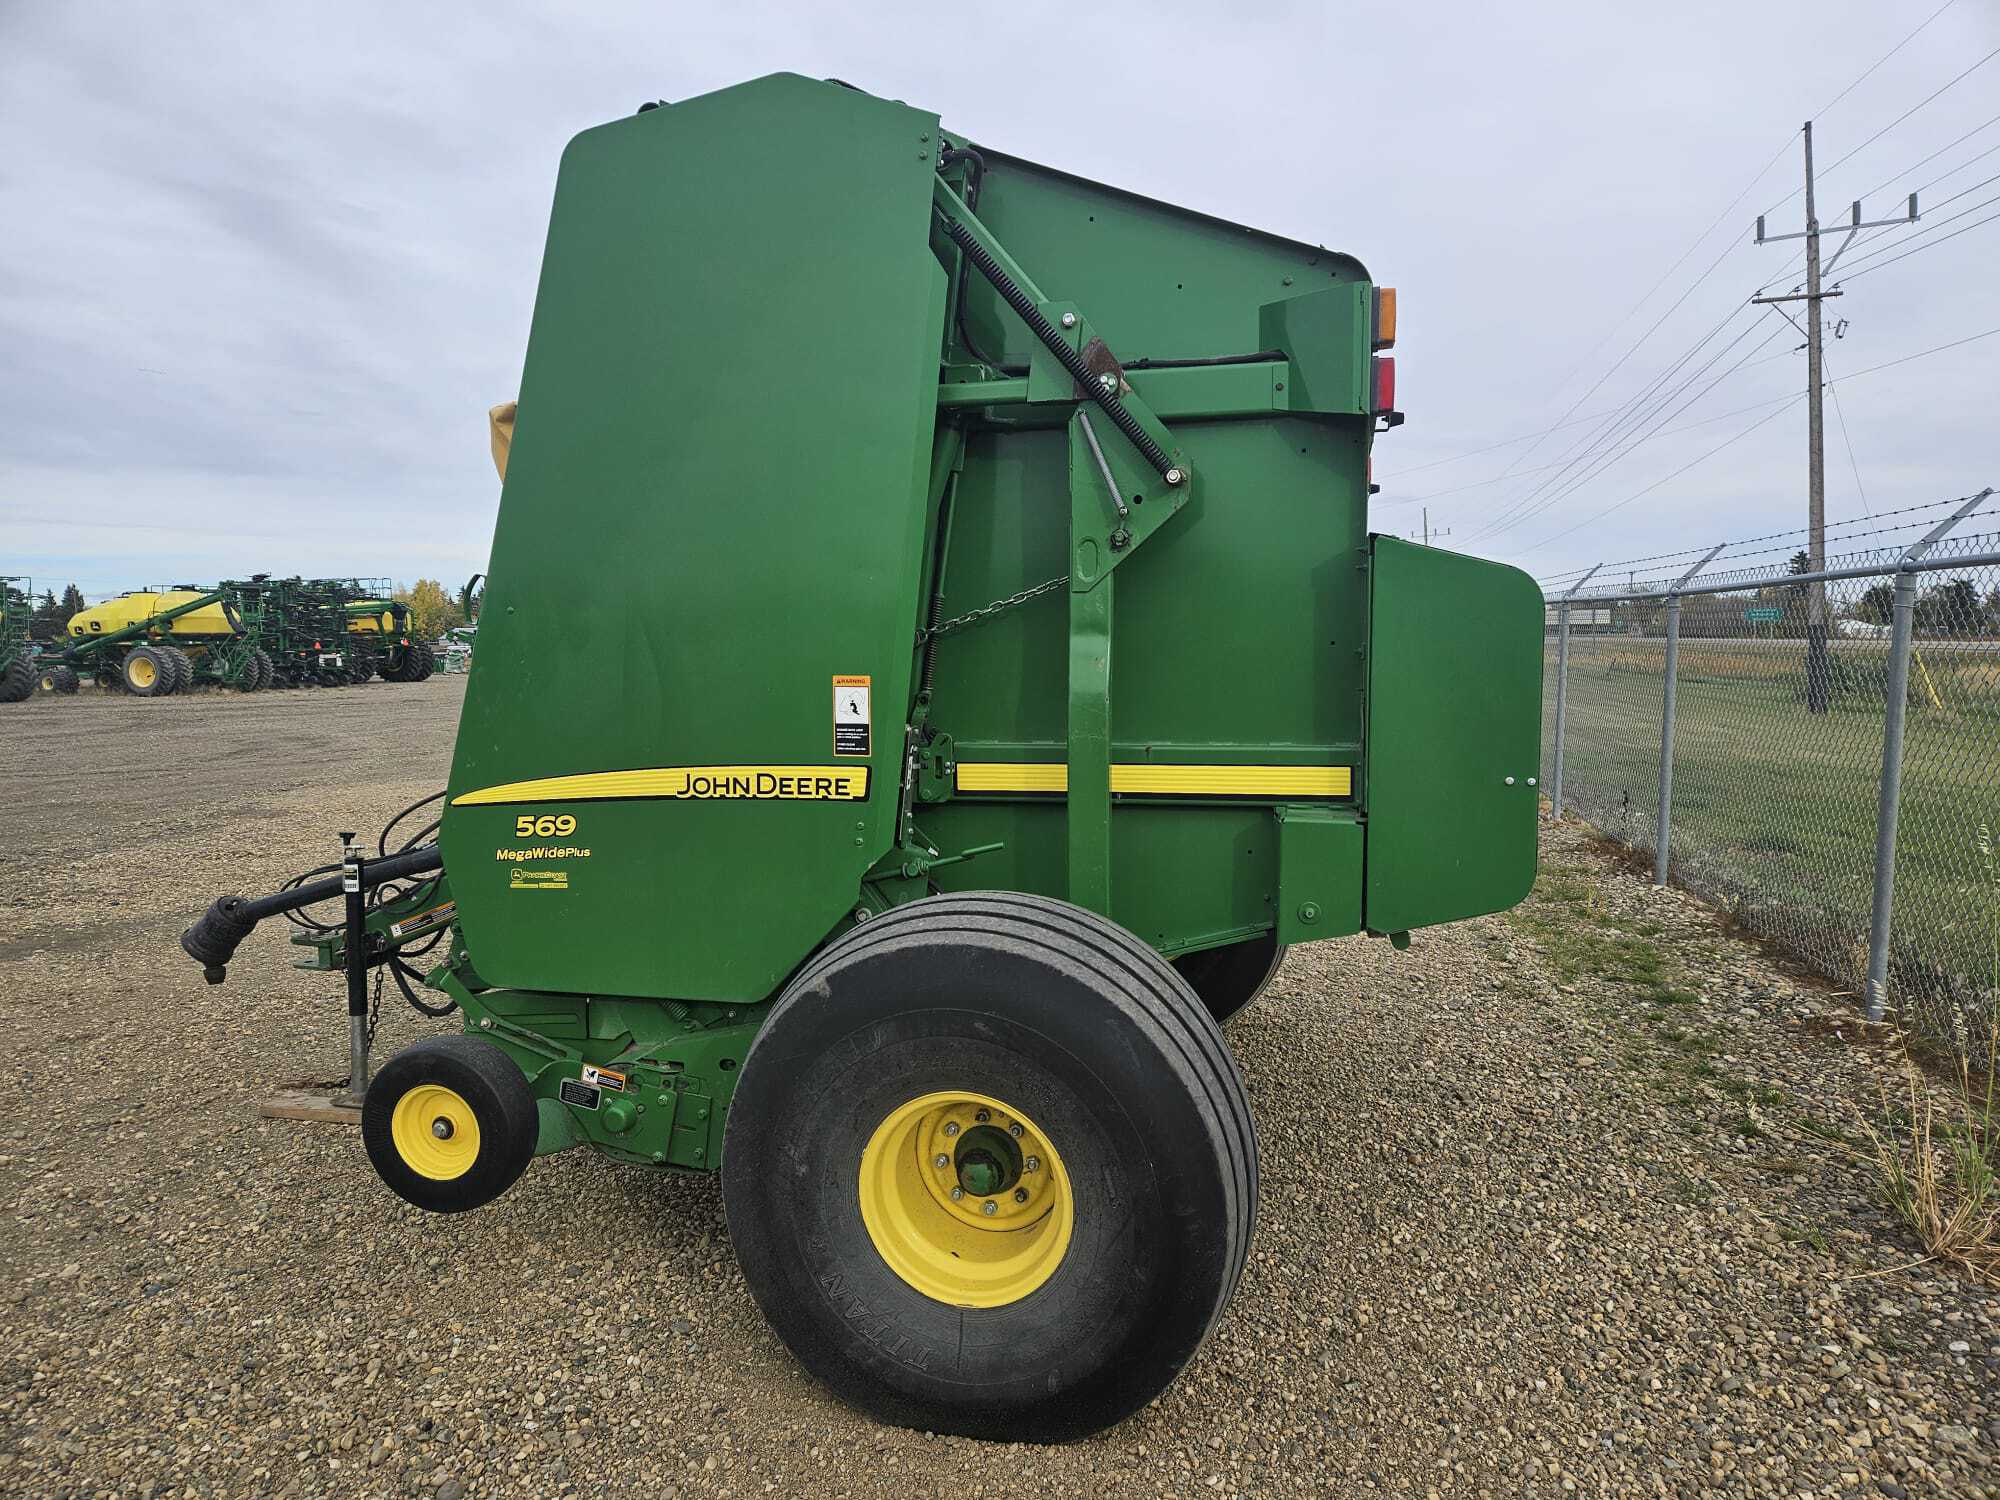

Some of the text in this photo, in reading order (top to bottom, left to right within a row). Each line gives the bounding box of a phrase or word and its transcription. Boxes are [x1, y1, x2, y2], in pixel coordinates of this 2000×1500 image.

[676, 773, 851, 796] JOHN DEERE
[515, 814, 577, 838] 569
[496, 847, 592, 862] MegaWidePlus
[819, 1272, 931, 1371] TITAN
